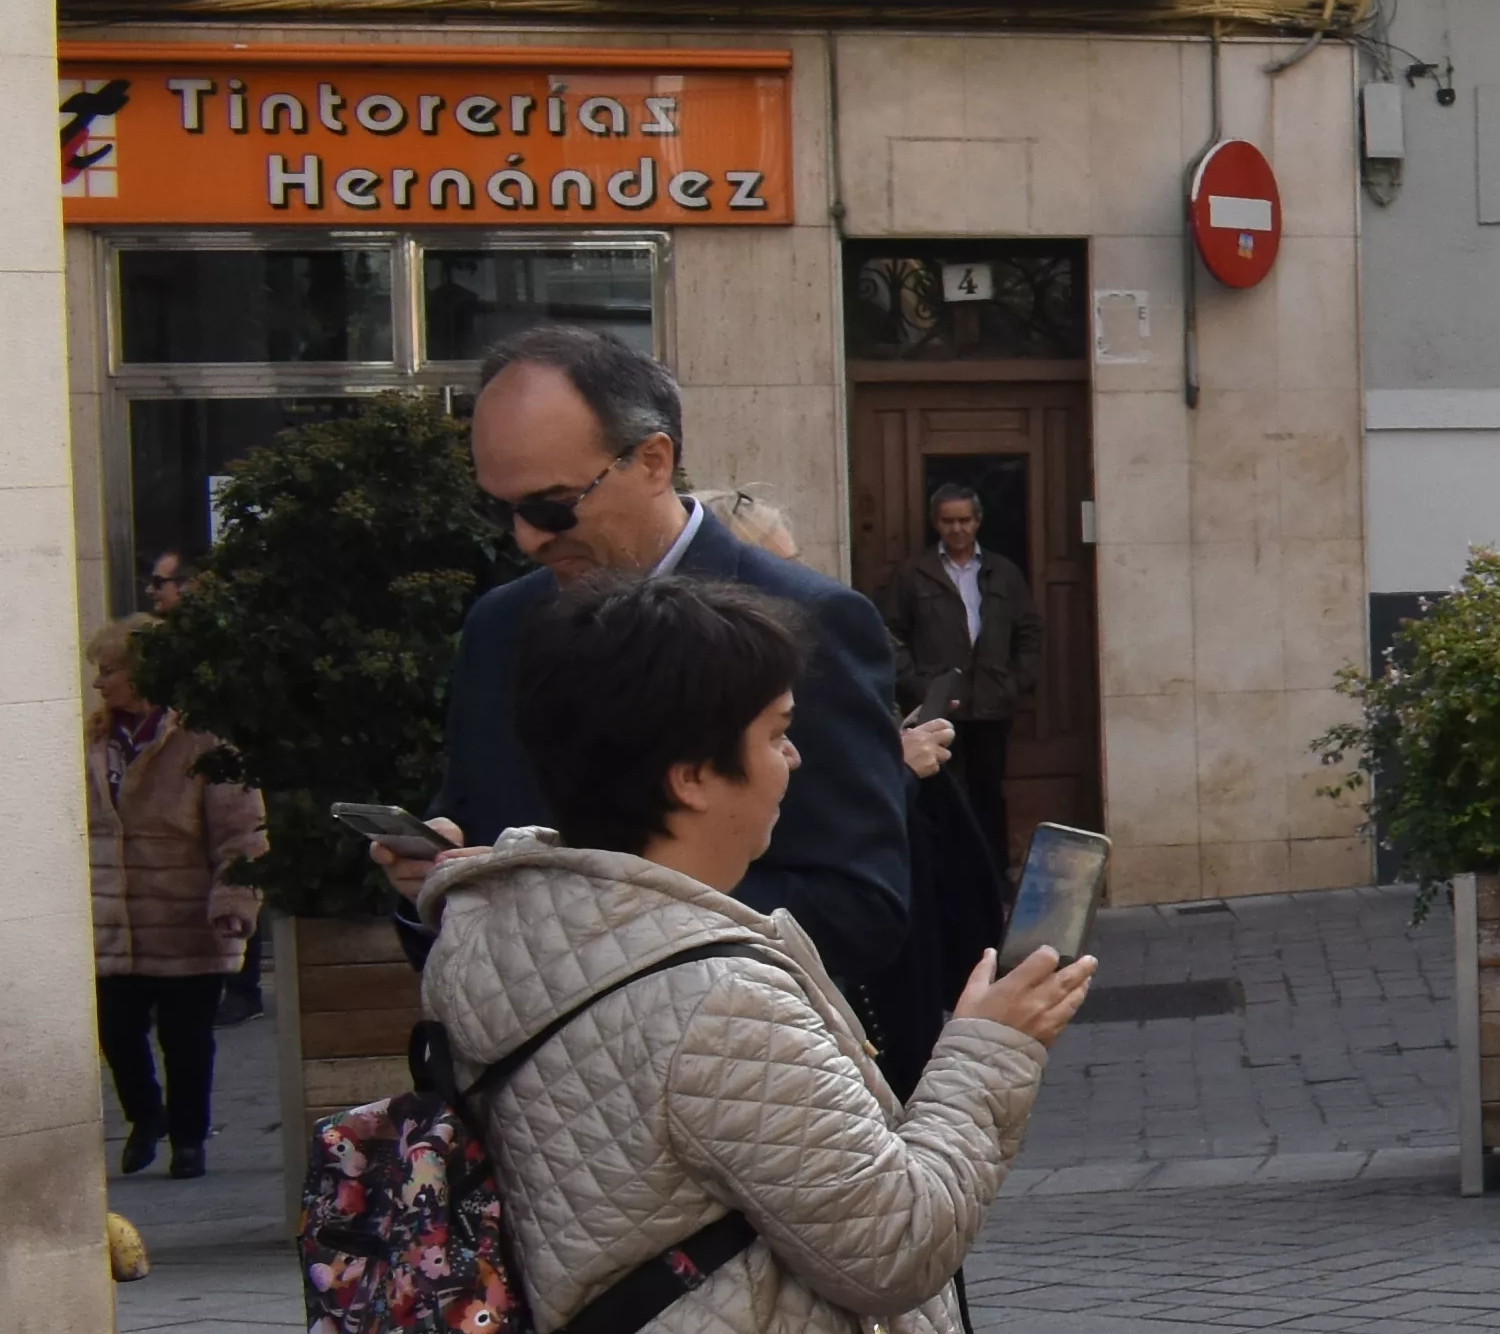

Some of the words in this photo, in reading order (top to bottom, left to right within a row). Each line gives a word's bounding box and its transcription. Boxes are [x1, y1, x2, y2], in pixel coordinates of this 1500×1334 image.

[167, 78, 682, 137] Tintorerías
[266, 152, 771, 212] Hernández
[957, 267, 979, 296] 4
